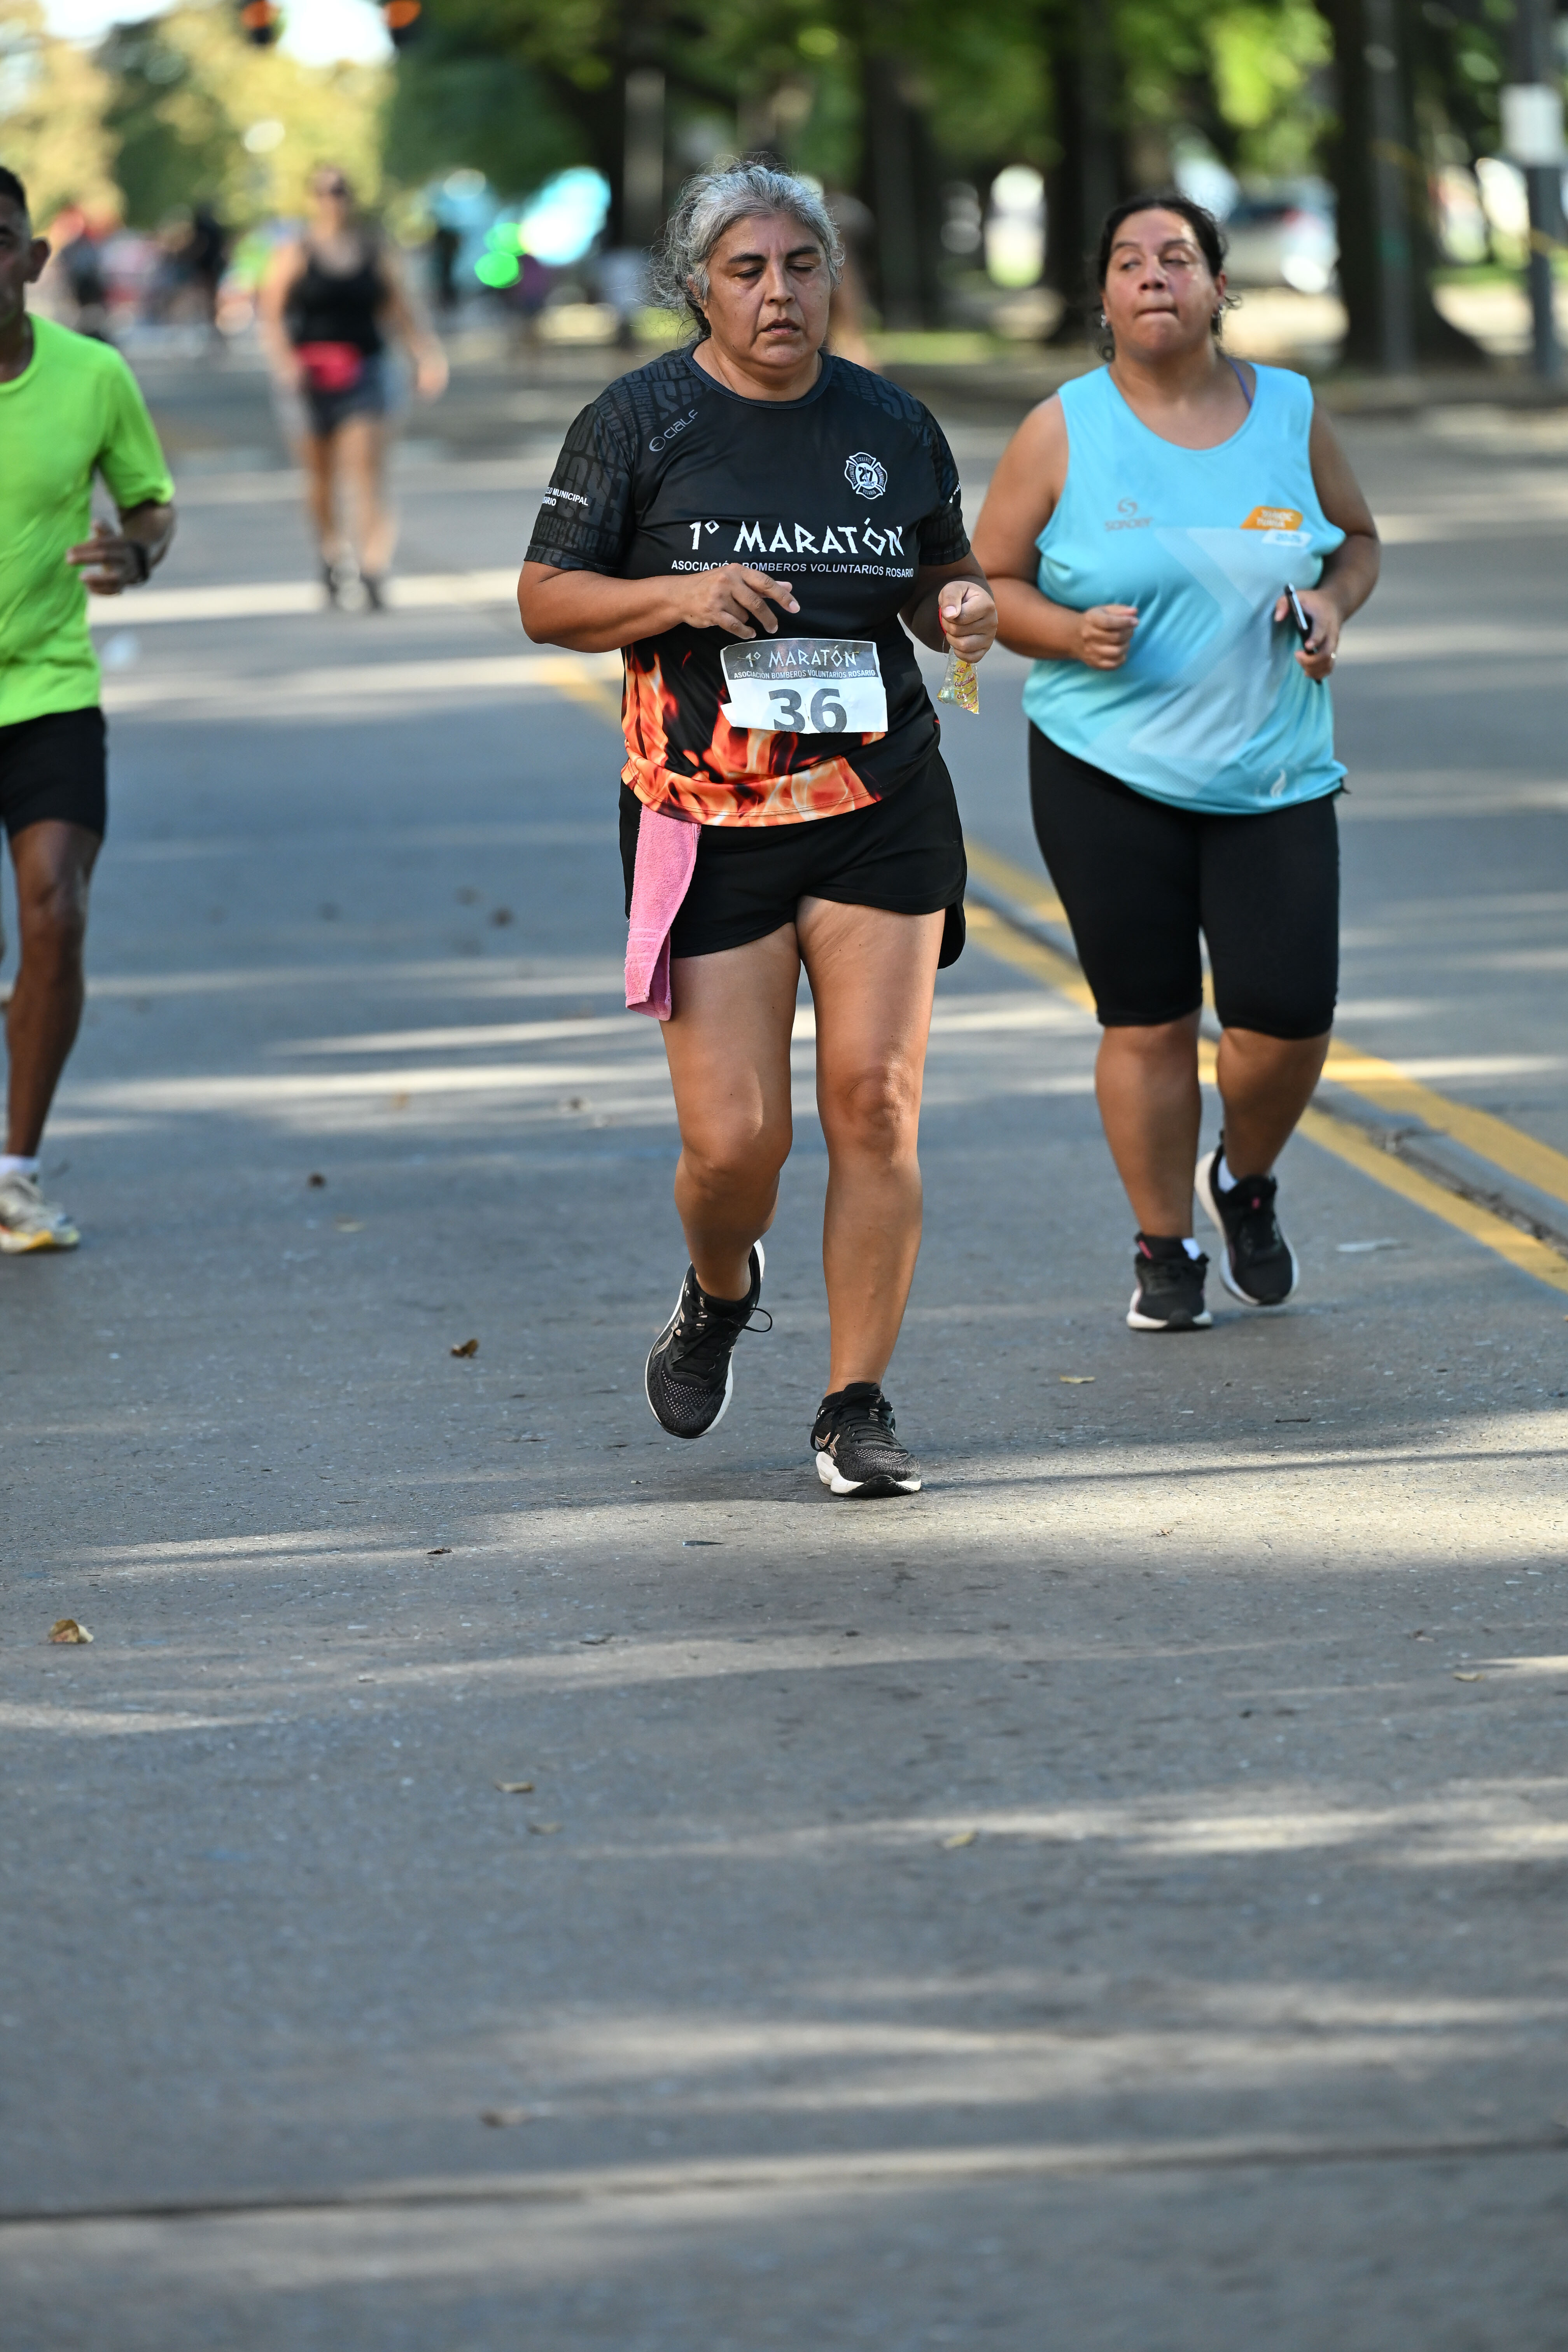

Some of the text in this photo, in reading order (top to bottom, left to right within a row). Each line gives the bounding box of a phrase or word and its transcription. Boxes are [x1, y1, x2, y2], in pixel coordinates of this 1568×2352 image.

[858, 466, 873, 482] 27
[552, 488, 589, 506] MUNICIPAL
[733, 517, 905, 556] MARATÓN
[671, 560, 914, 578] ASOCIACIÓ BOMBEROS VOLUNTARIOS ROSARIO
[768, 645, 857, 668] MARATÓN
[772, 670, 806, 679] BOMBEROS
[807, 669, 847, 678] VOLUNTARIOS
[848, 669, 876, 678] ROSARIO
[768, 688, 847, 733] 36
